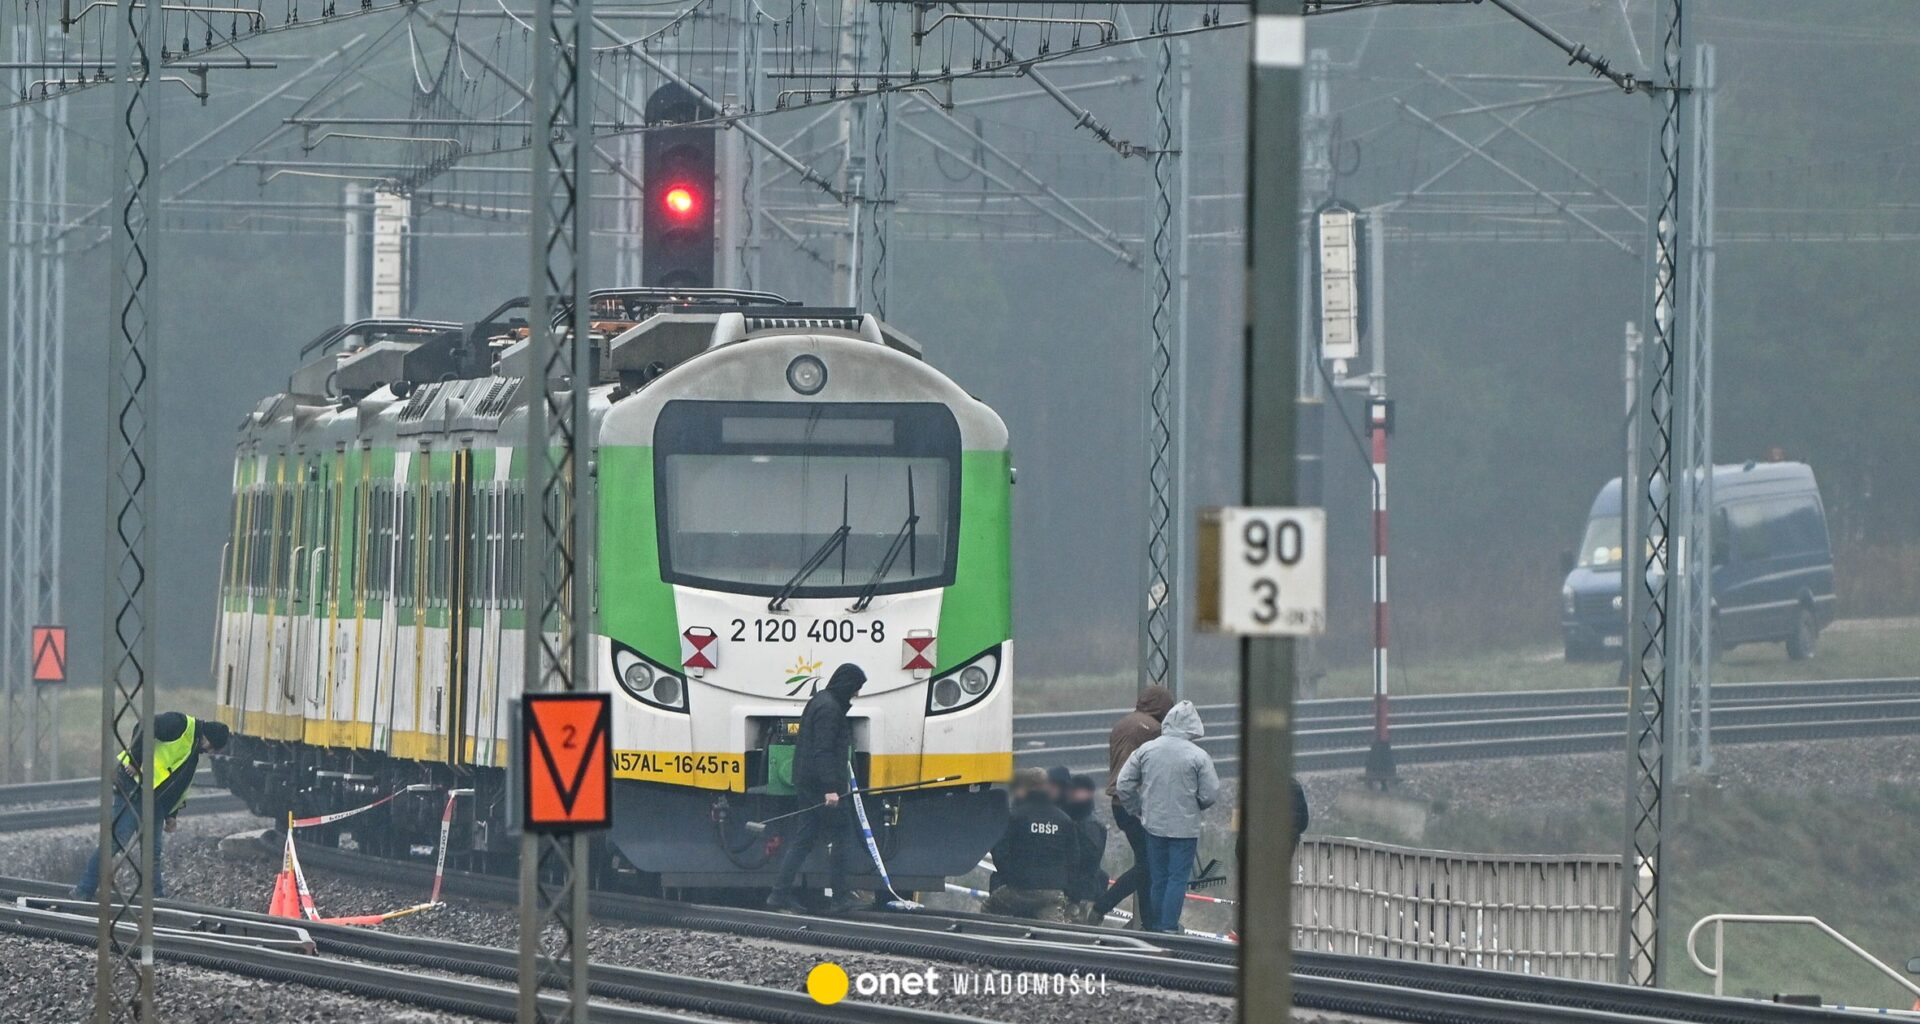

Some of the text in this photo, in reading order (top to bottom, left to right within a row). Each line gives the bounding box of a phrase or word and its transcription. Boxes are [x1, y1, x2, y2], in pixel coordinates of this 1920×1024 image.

[1244, 519, 1304, 566] 90
[1251, 577, 1279, 625] 3
[731, 619, 885, 643] 2 120 400-8
[562, 724, 576, 749] 2
[612, 753, 740, 774] N57AL-1645ra
[1031, 821, 1059, 835] CBŚP
